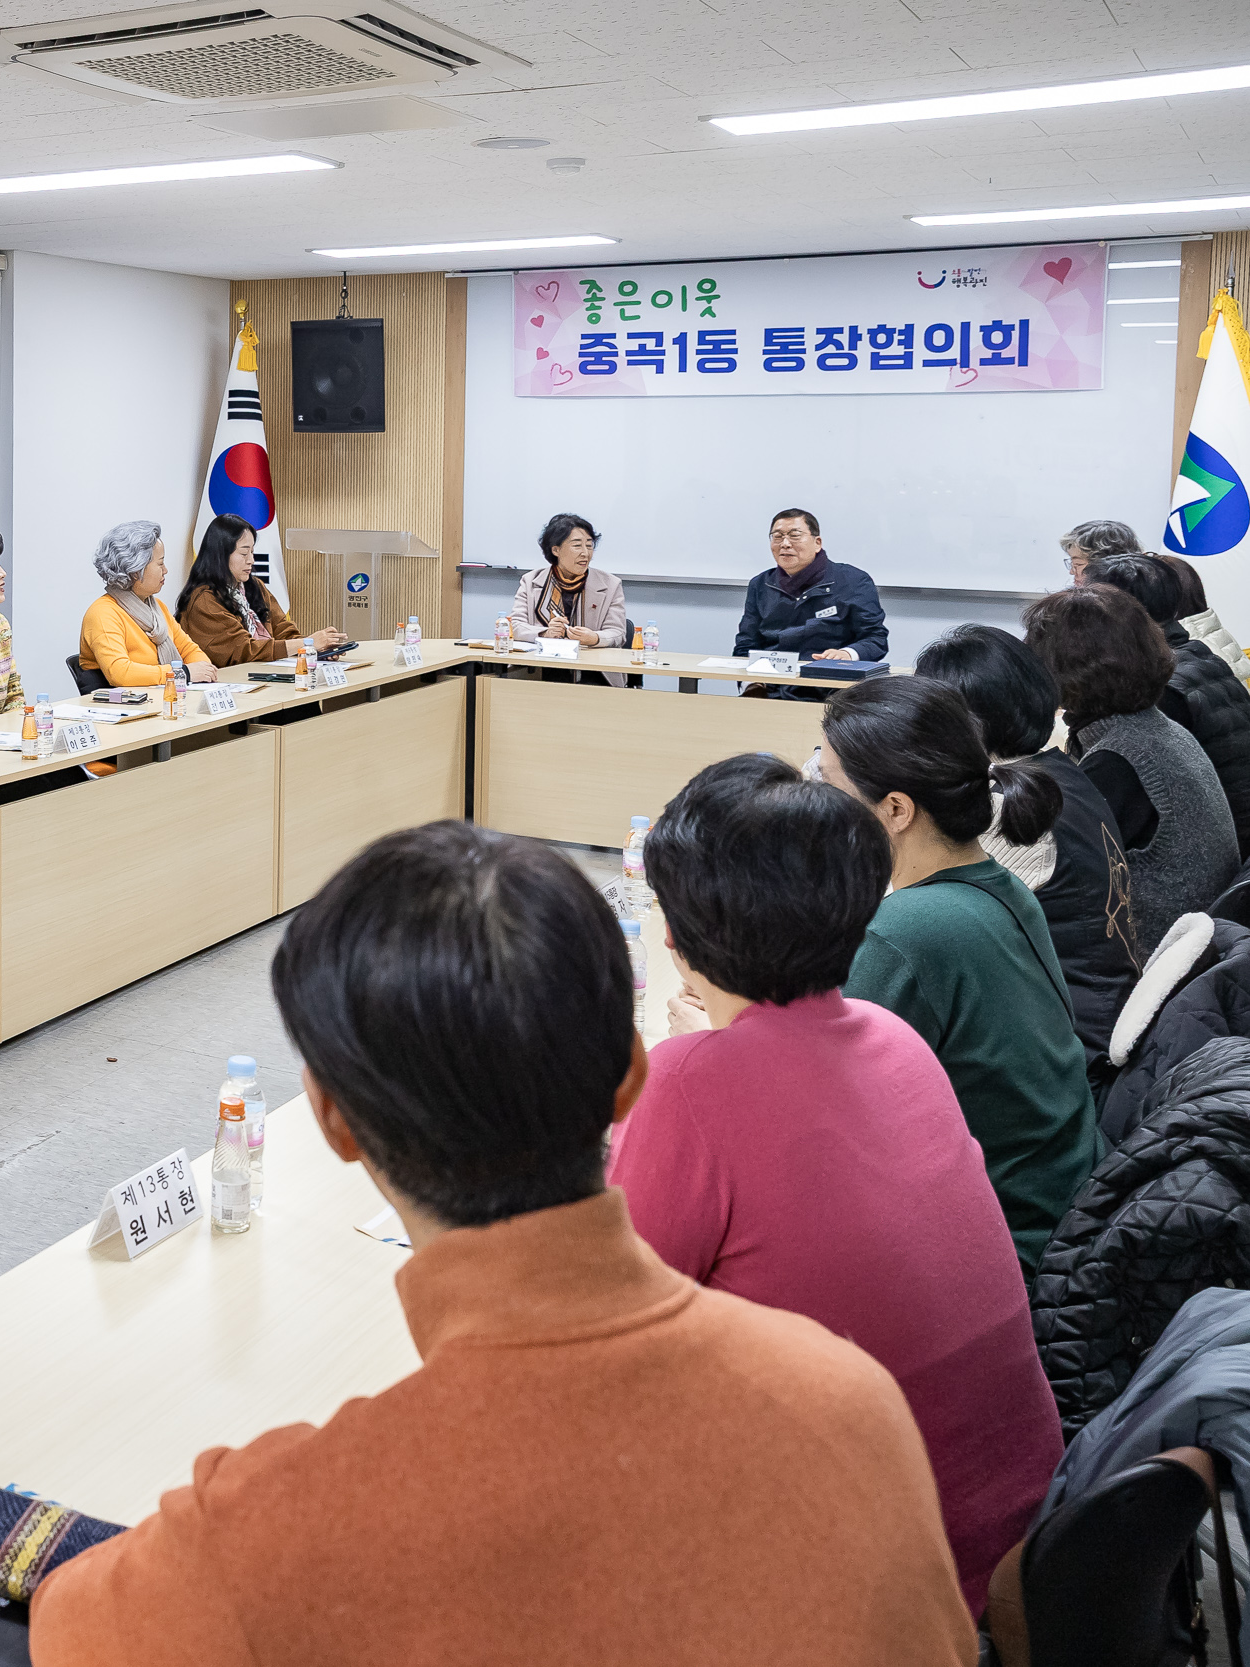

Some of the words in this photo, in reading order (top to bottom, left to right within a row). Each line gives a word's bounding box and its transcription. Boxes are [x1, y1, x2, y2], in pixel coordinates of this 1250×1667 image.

[581, 277, 721, 325] 좋은이웃
[577, 329, 740, 376] 중곡1동
[761, 318, 1031, 373] 통장협의회
[68, 723, 91, 736] 제3통장
[120, 1156, 185, 1206] 제13통장
